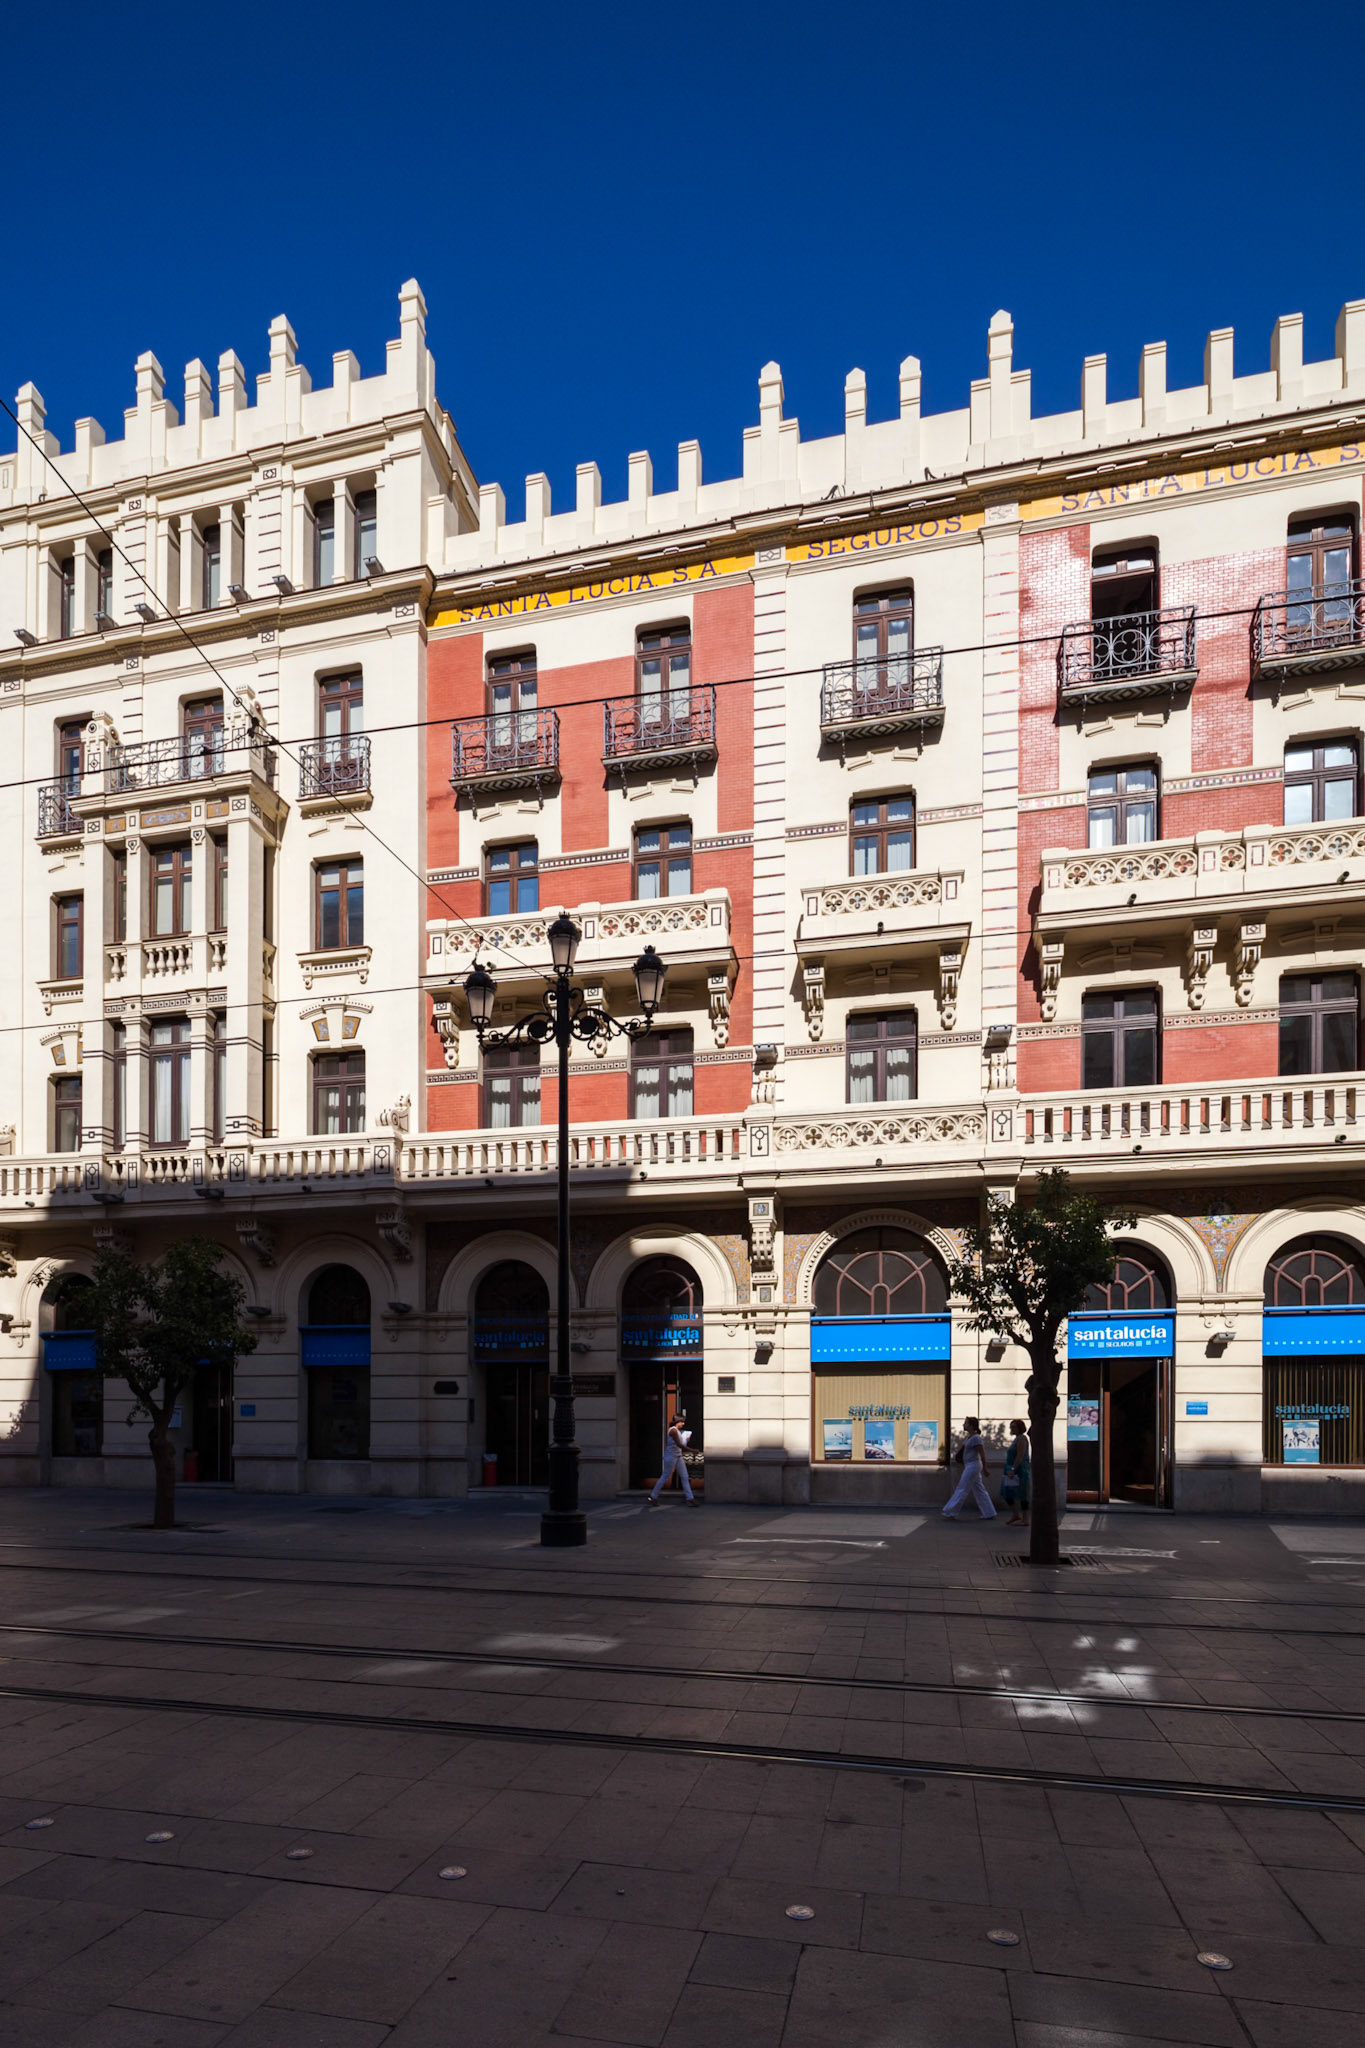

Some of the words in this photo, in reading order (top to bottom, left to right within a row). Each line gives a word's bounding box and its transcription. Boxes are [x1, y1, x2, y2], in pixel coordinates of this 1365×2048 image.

[1061, 473, 1183, 512] SANTA
[808, 515, 962, 559] SEGUROS
[460, 591, 552, 623] SANTA
[1074, 1325, 1167, 1341] santalucía
[1275, 1403, 1350, 1414] santalucía
